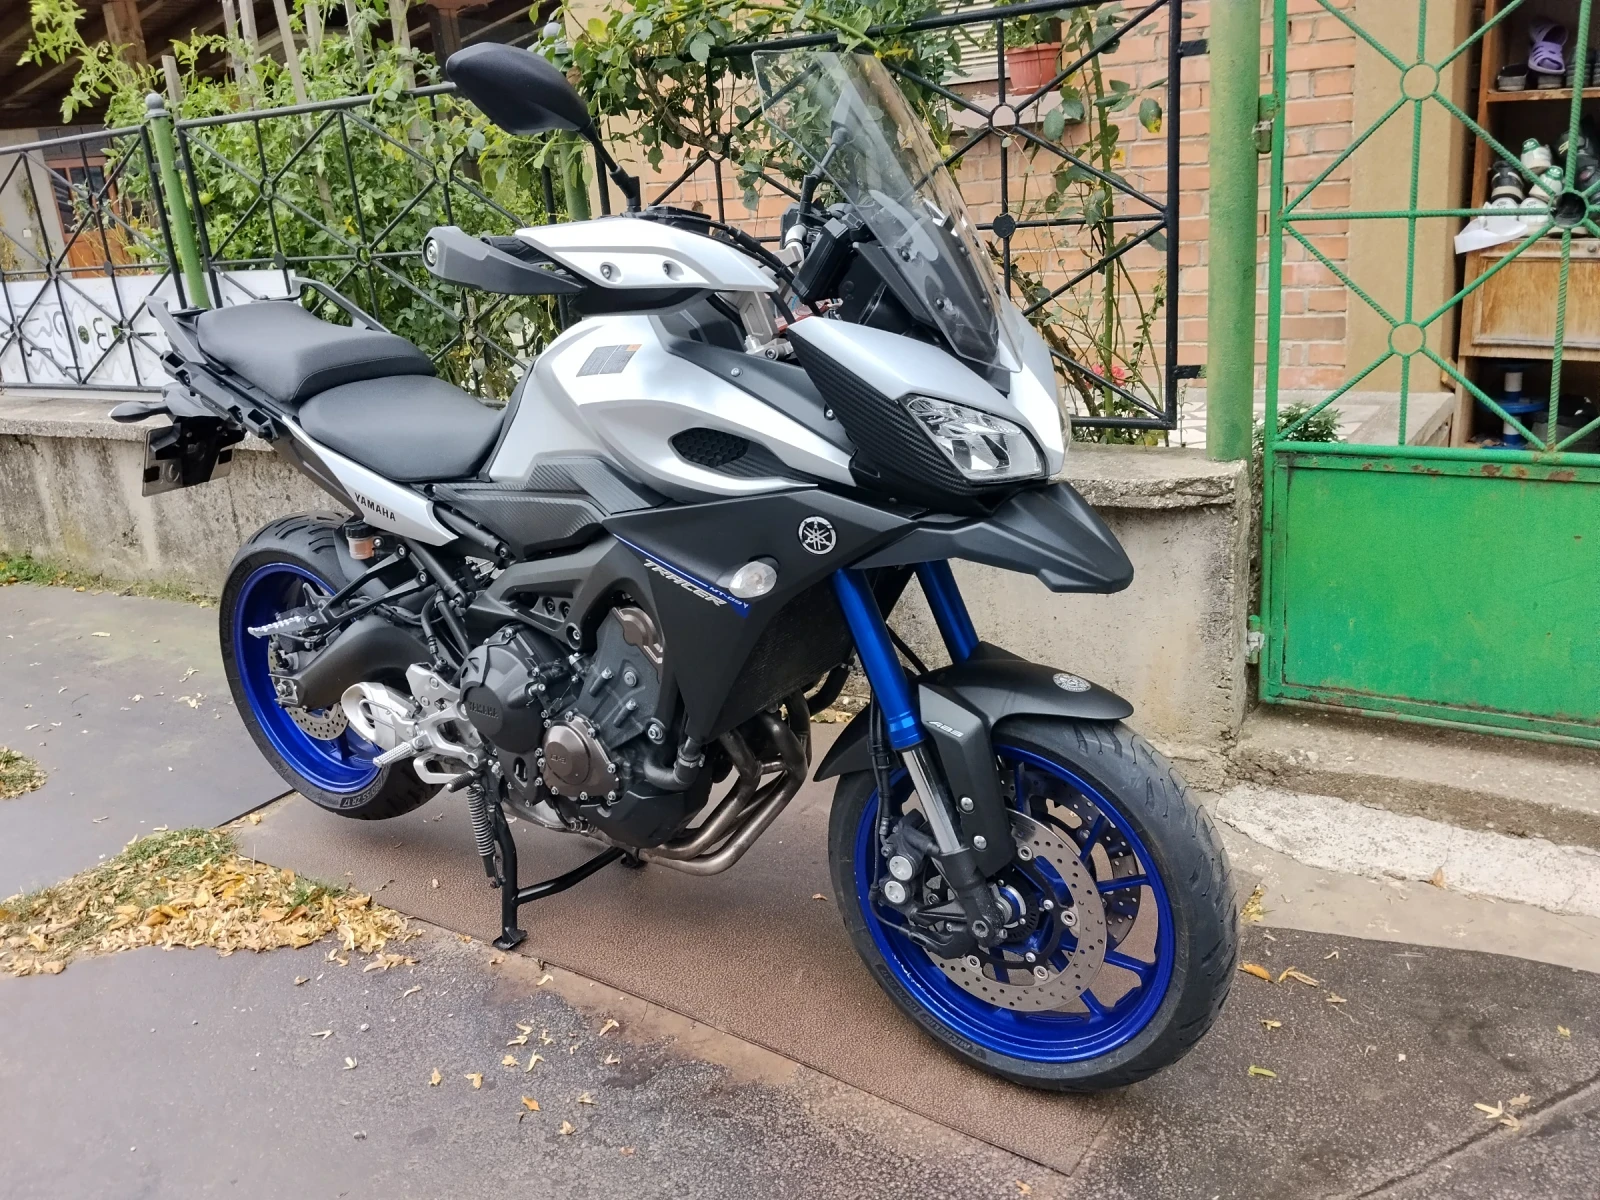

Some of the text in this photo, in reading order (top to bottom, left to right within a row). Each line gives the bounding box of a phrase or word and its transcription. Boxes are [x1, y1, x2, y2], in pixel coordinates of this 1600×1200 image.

[354, 492, 396, 522] YAMAHA
[643, 558, 728, 607] TRACER
[927, 721, 964, 738] ABS
[342, 798, 351, 807] 17
[922, 1014, 971, 1050] MICHELIN
